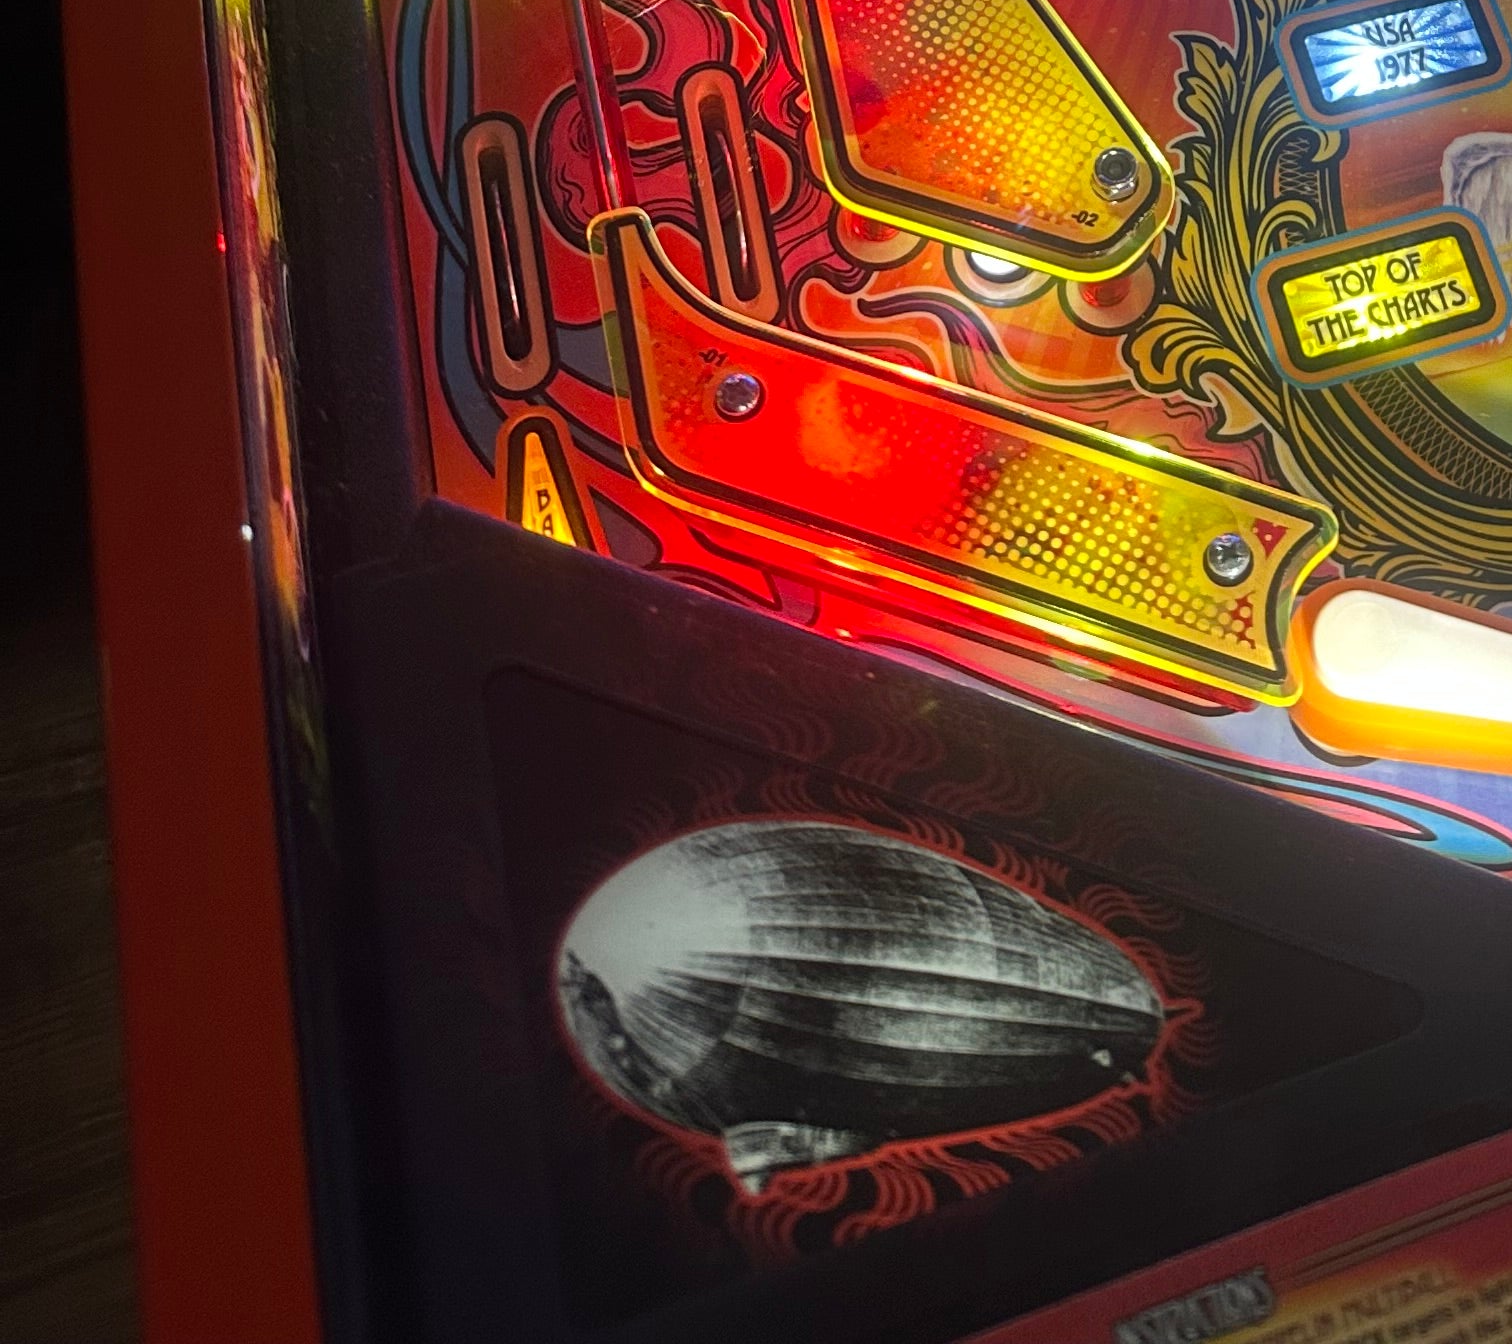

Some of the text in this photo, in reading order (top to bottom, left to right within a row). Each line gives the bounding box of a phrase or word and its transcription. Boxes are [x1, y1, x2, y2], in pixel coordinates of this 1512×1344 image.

[1362, 18, 1417, 46] USA
[1375, 46, 1429, 81] 1977
[1325, 252, 1424, 303] TOP OF
[1307, 280, 1468, 347] THE CHARTS
